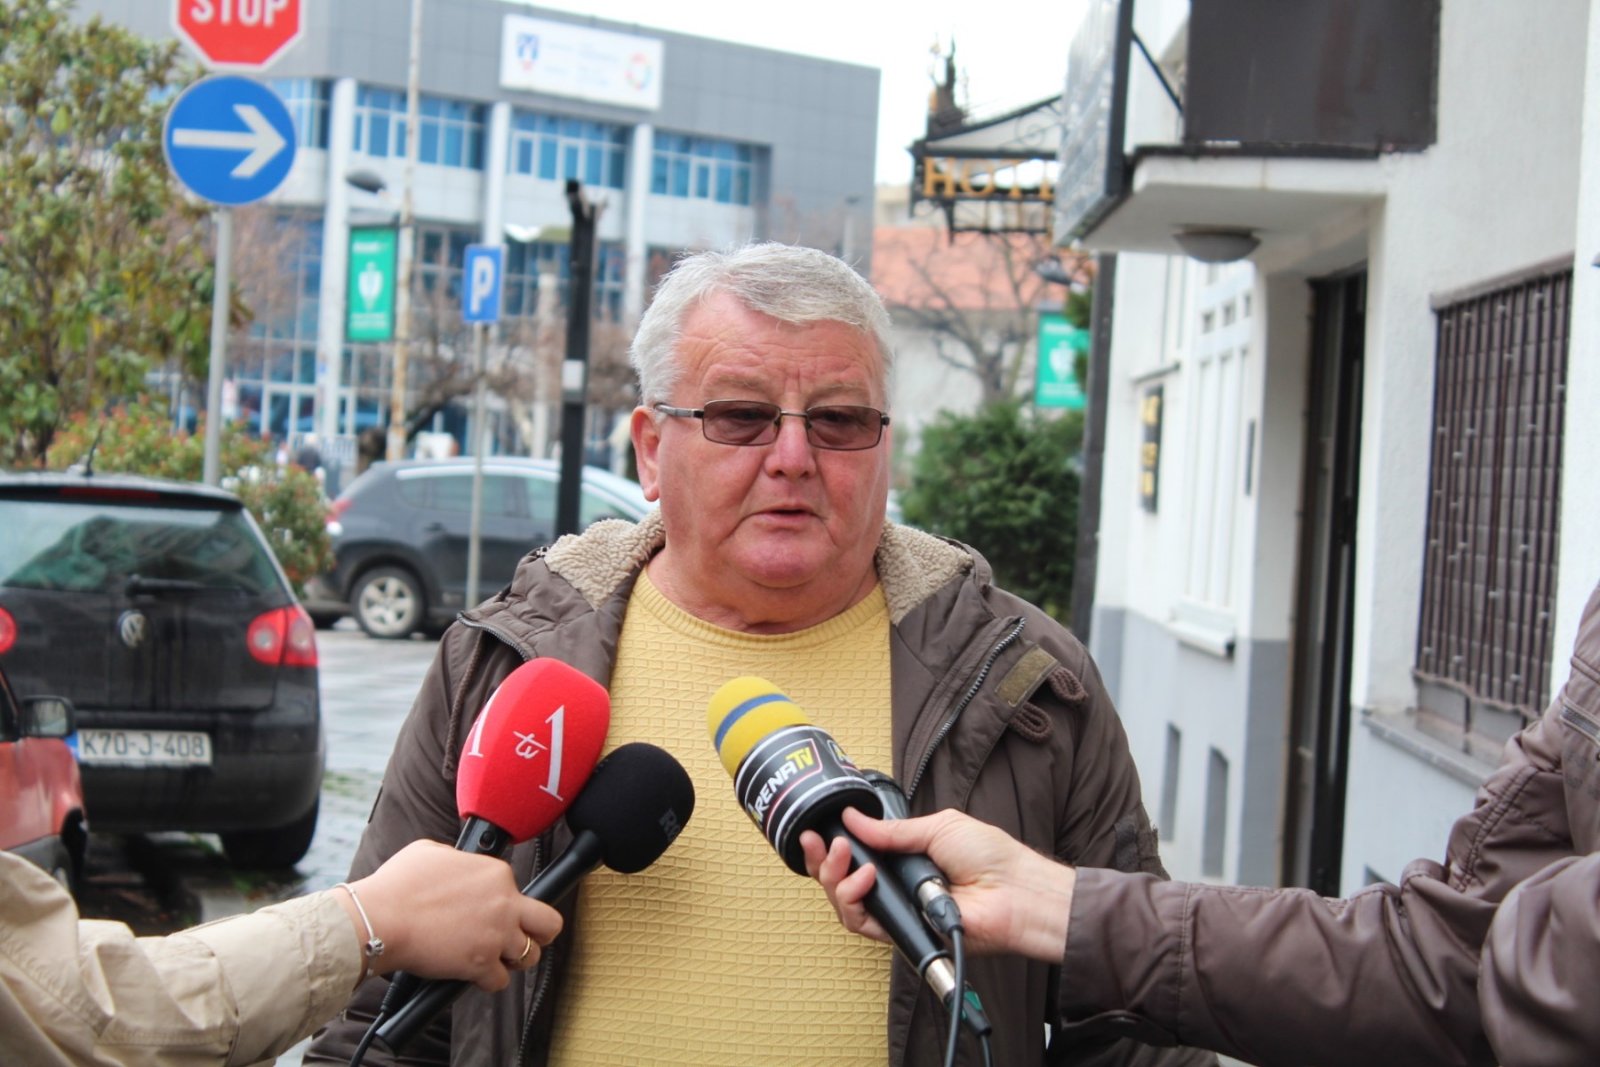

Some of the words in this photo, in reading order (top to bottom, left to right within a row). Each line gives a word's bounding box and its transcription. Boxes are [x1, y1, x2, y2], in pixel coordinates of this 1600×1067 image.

[190, 0, 289, 27] STOP
[470, 255, 495, 315] P
[83, 731, 206, 758] K70-J-408
